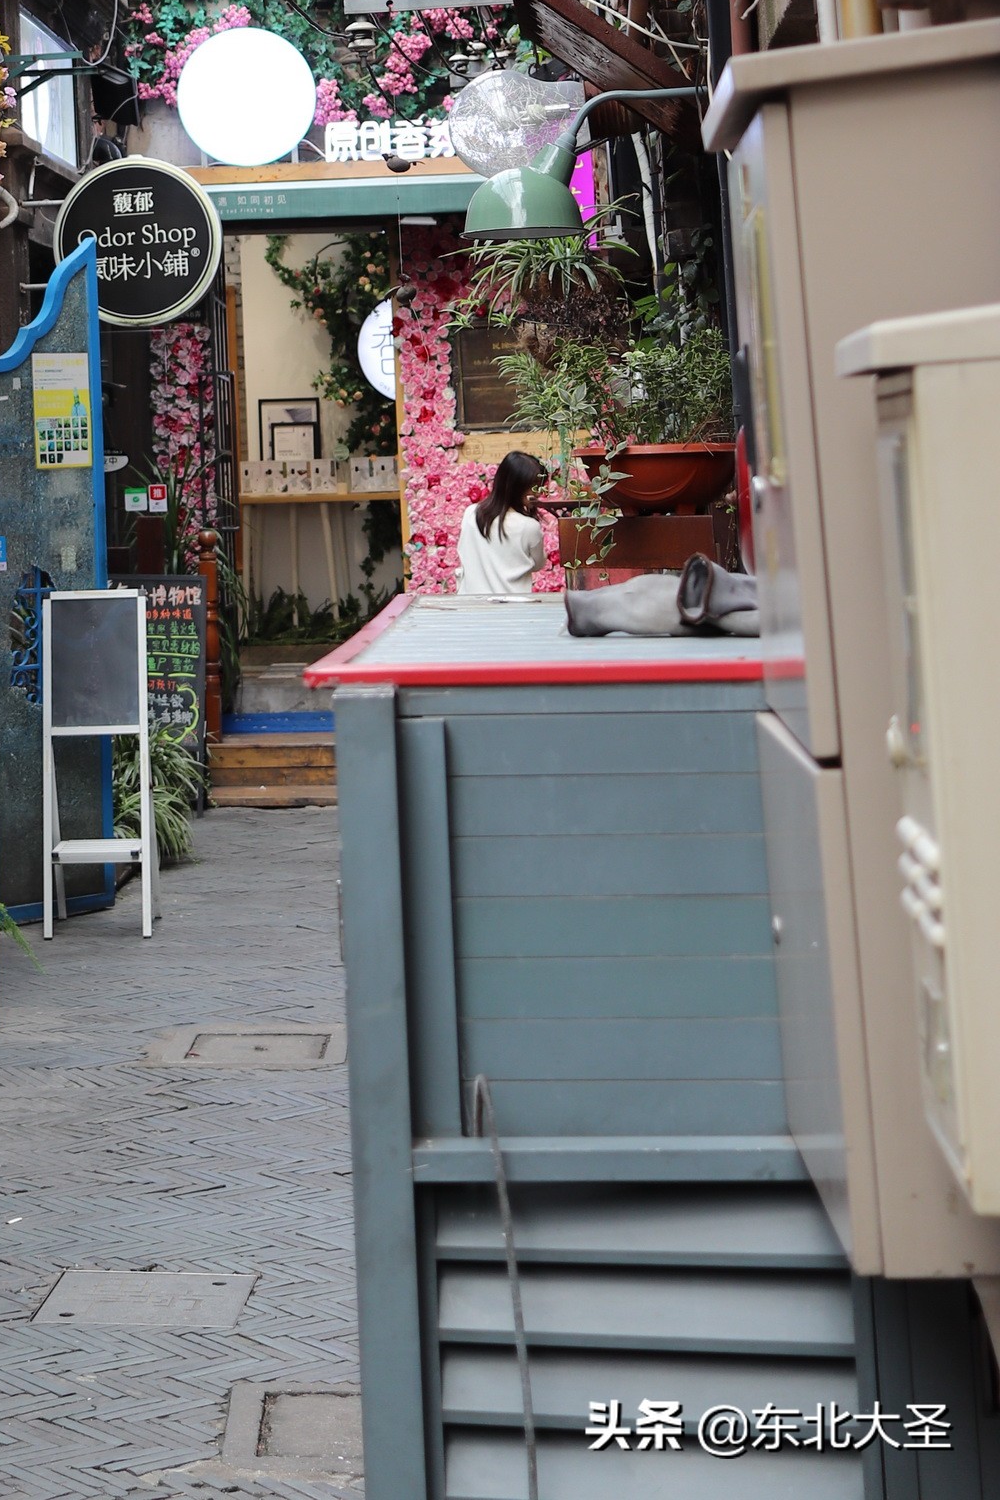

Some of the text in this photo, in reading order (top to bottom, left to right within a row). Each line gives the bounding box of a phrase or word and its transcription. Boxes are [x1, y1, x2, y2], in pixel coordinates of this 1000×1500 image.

[112, 191, 154, 214] 馥郁
[237, 194, 287, 206] 如同初见
[142, 222, 197, 248] Shop
